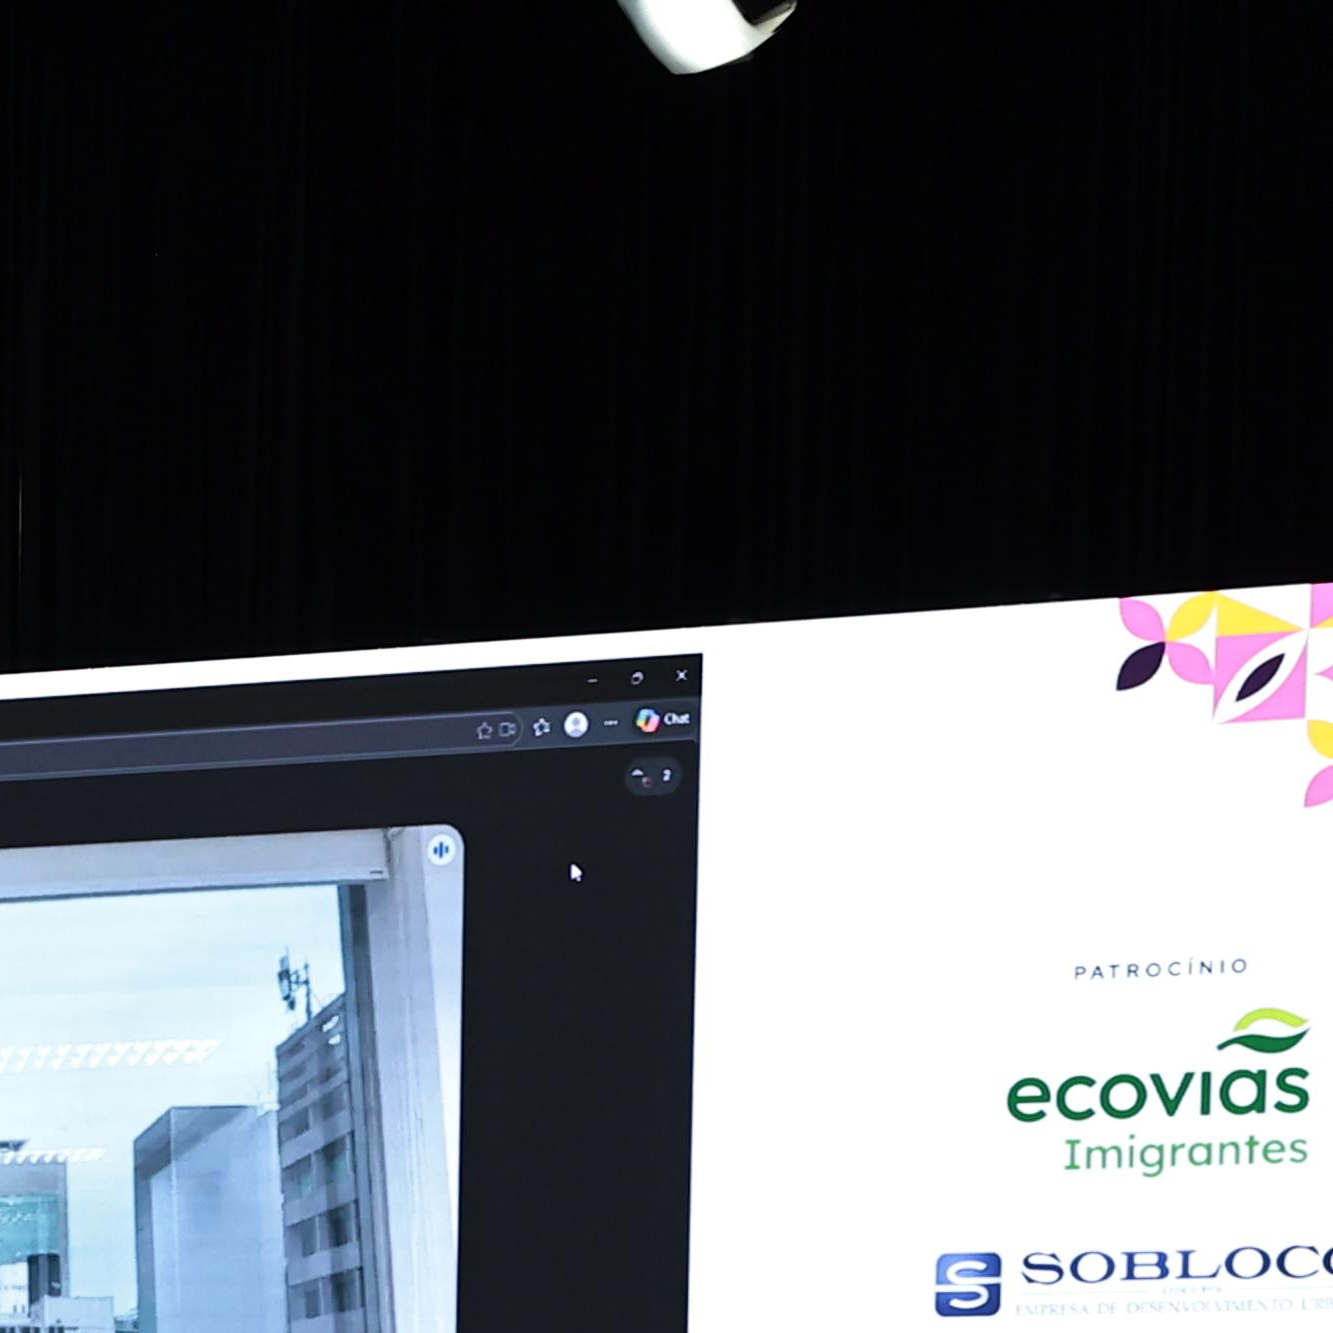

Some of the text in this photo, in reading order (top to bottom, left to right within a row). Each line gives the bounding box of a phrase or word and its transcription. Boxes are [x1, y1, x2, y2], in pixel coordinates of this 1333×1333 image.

[664, 712, 690, 725] Chat
[1074, 957, 1248, 980] PATROCÍNIO
[1006, 1066, 1310, 1123] ecovias
[1064, 1133, 1308, 1178] Imigrantes
[1021, 1244, 1333, 1286] SOBLOC
